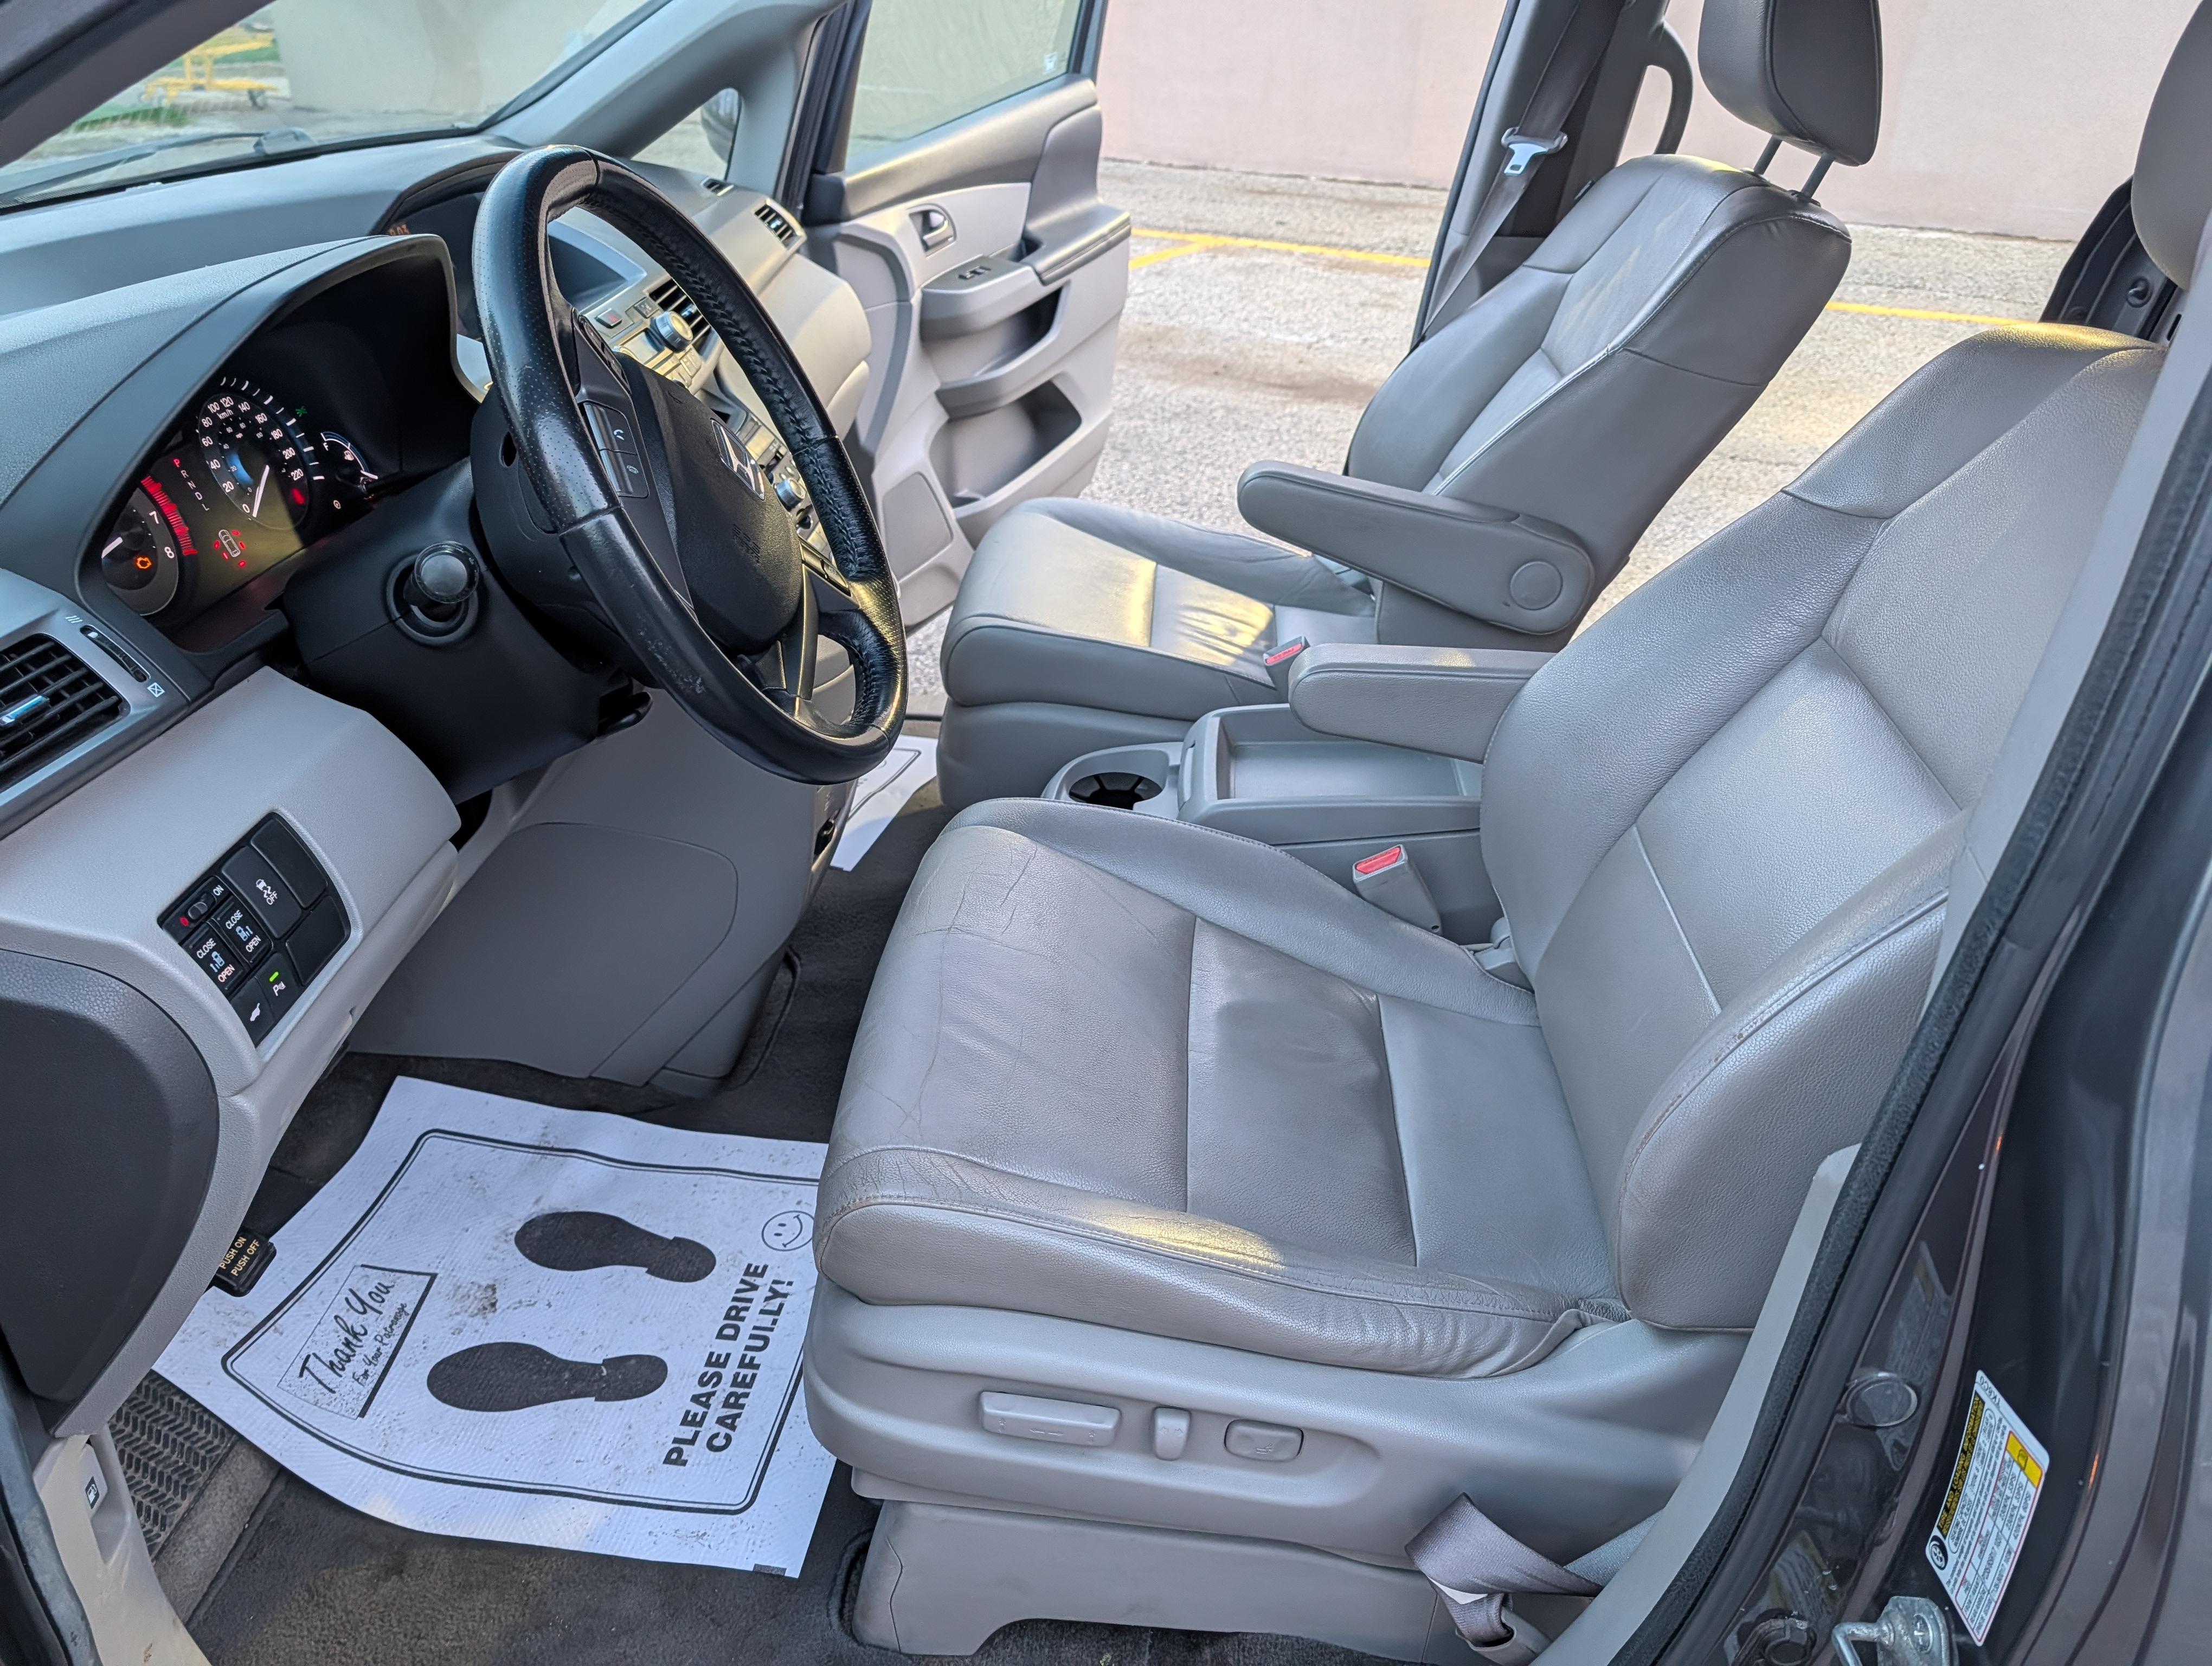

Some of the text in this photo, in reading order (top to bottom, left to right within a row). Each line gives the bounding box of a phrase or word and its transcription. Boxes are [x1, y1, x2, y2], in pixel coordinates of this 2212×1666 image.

[208, 402, 220, 413] 100
[220, 396, 234, 407] 120
[238, 401, 250, 413] 140
[217, 409, 234, 420] km/h
[255, 413, 267, 424] 160
[202, 417, 213, 427] 80
[271, 428, 283, 440] 180
[202, 436, 213, 447] 60
[323, 443, 329, 451] F
[282, 447, 295, 460] 200
[210, 459, 221, 470] 40
[173, 458, 181, 467] P
[181, 470, 189, 478] R
[187, 480, 196, 490] N
[195, 492, 203, 500] D
[291, 468, 304, 480] 220
[222, 481, 234, 493] 20
[242, 504, 250, 513] 0
[149, 510, 159, 524] 7
[164, 546, 175, 559] 8
[213, 885, 224, 896] ON
[266, 890, 278, 905] OFF
[225, 909, 243, 930] CLOSE
[196, 938, 216, 959] CLOSE
[246, 935, 261, 952] OPEN
[217, 964, 235, 982] OPEN
[219, 1236, 247, 1270] PUSH ON
[230, 1239, 260, 1277] PUSH OFF
[299, 1282, 395, 1394] Thank You
[352, 1368, 370, 1387] For
[362, 1347, 382, 1367] Your
[663, 1263, 769, 1466] PLEASE DRIVE
[706, 1279, 794, 1452] CAREFULLY!
